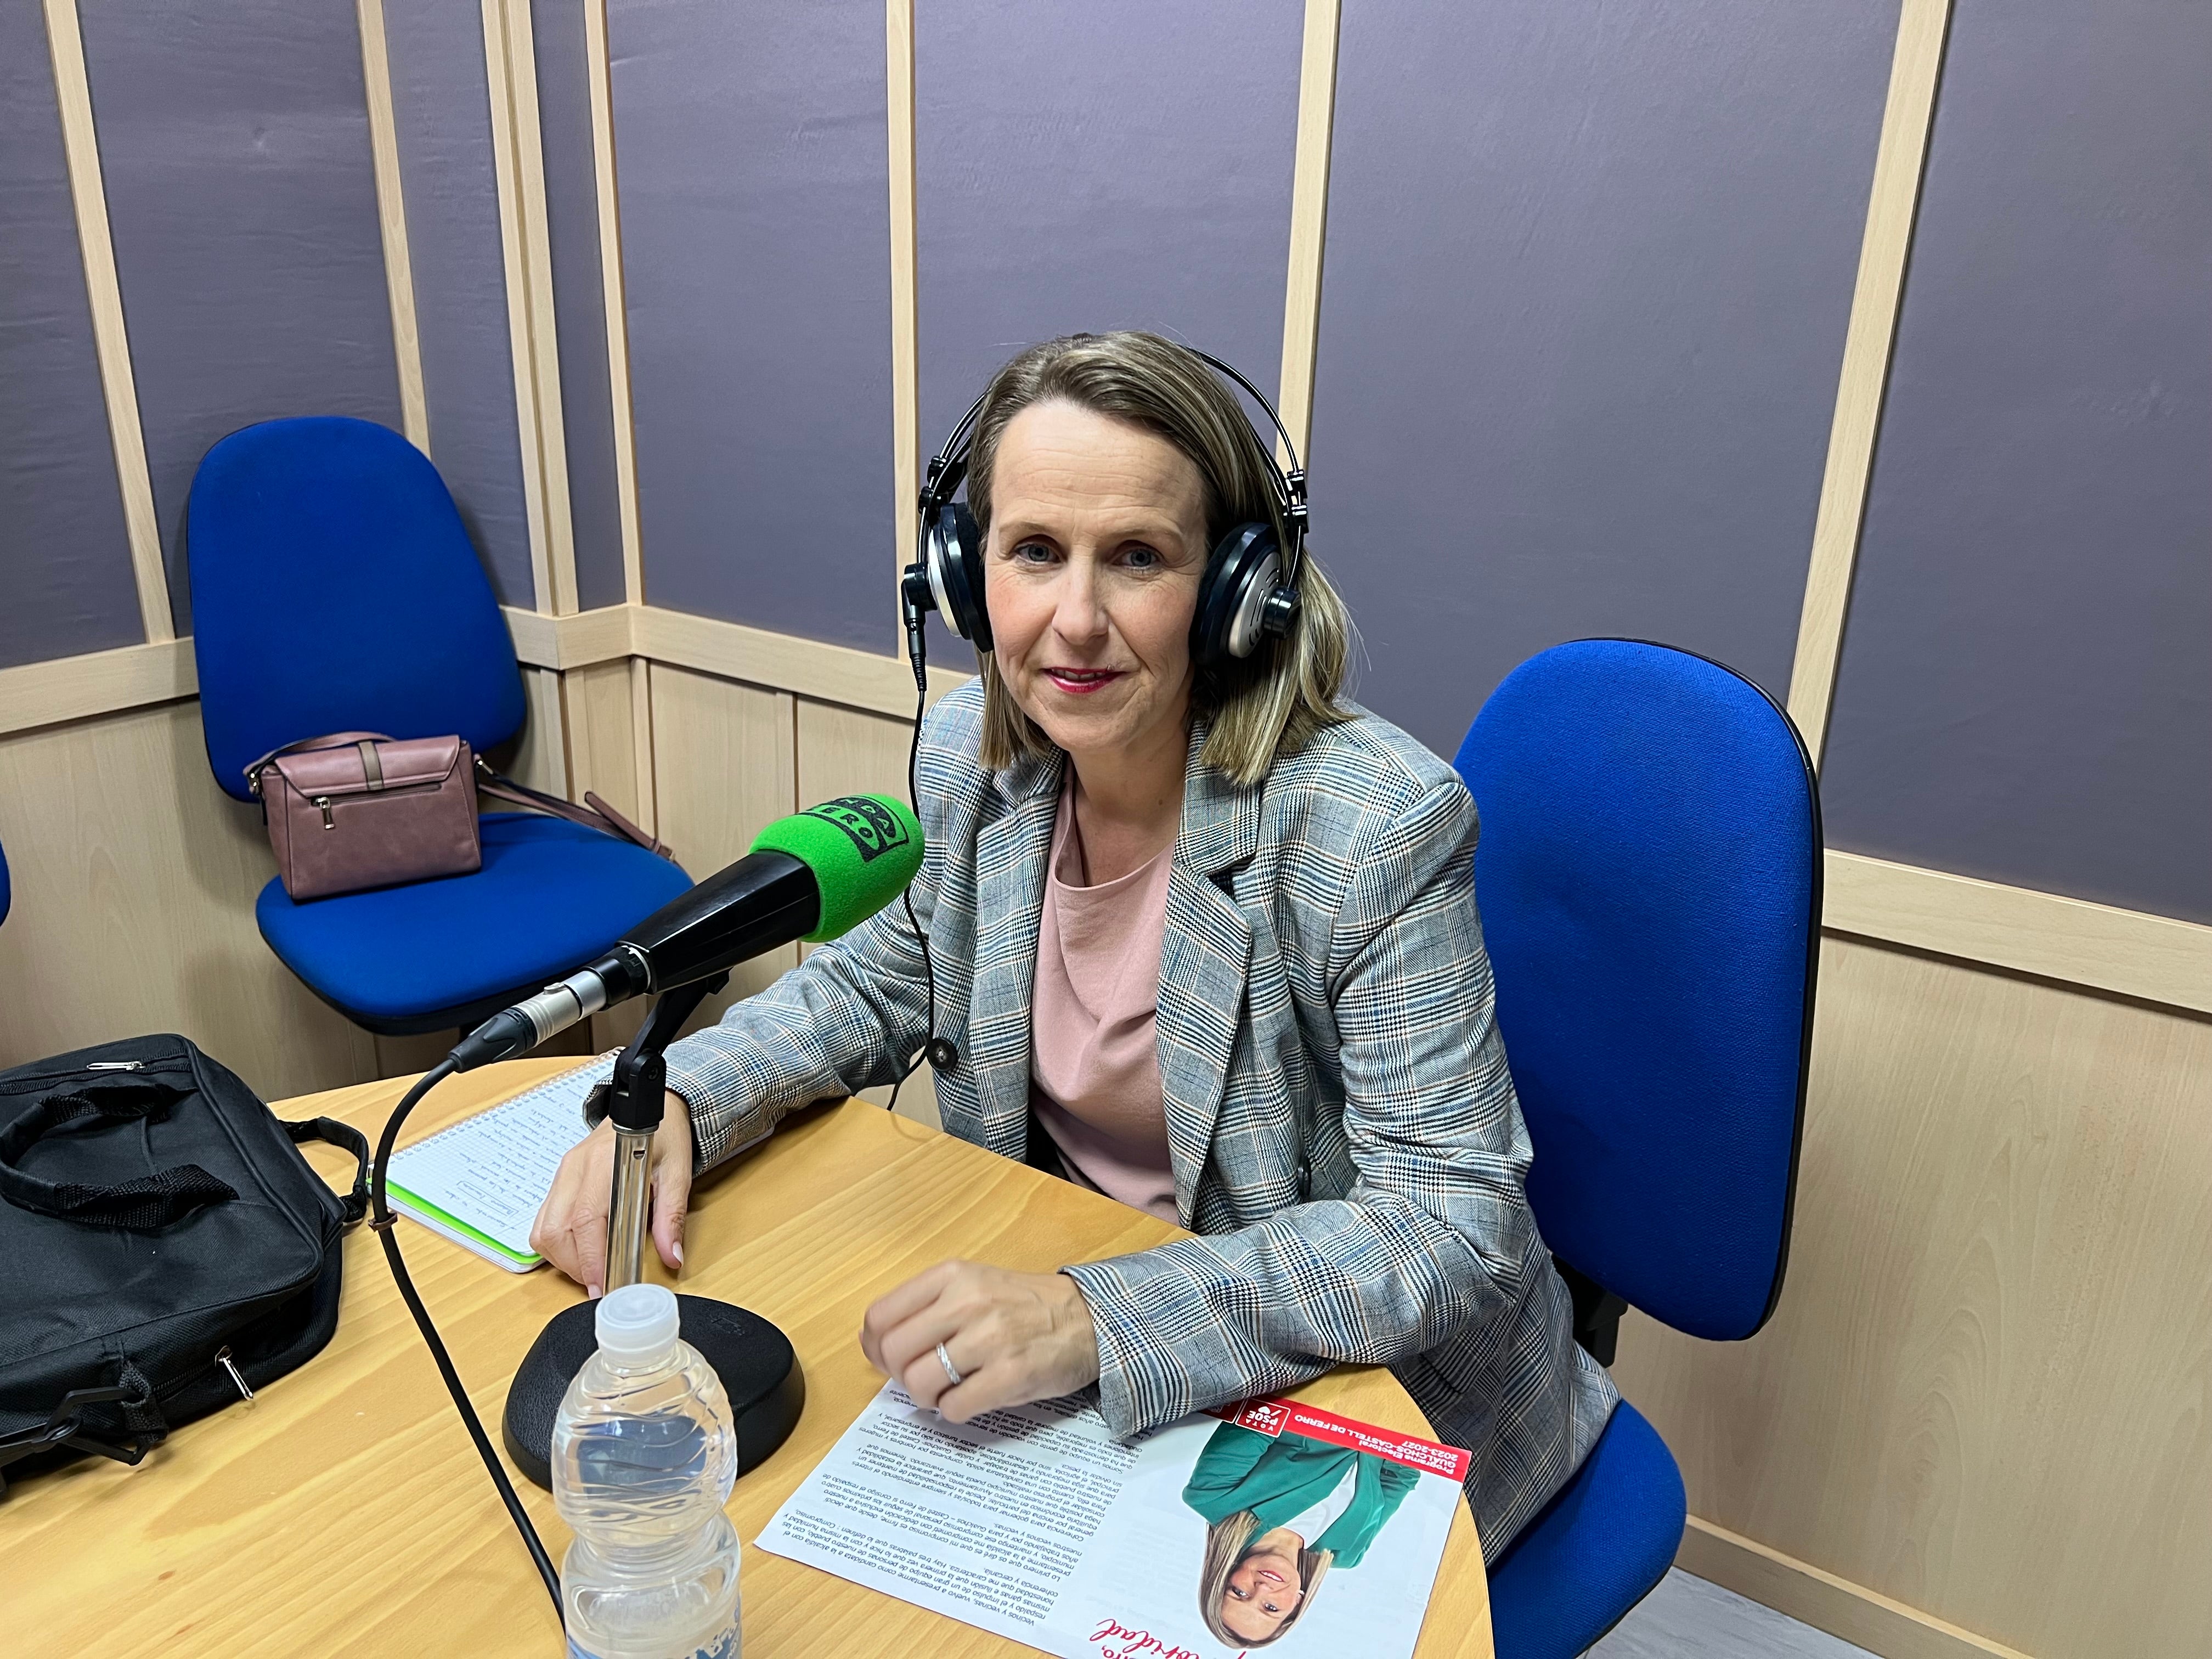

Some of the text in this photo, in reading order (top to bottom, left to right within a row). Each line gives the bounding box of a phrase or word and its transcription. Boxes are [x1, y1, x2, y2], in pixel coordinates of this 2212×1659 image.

[1245, 1418, 1274, 1431] VOTA
[1246, 1410, 1279, 1426] PSOE
[880, 1421, 900, 1430] sector
[858, 1427, 884, 1438] mujeres
[889, 1437, 917, 1450] hombres
[1294, 1414, 1457, 1468] GUALCHOS-CASTELL DE FERRO
[944, 1441, 977, 1455] apostando
[1402, 1440, 1459, 1462] 2023-2027
[861, 1449, 895, 1463] estabilidad
[929, 1450, 963, 1464] compuesta
[1358, 1440, 1454, 1475] Programa Electoral
[867, 1459, 899, 1472] mantener
[903, 1463, 933, 1475] garantice
[881, 1471, 921, 1486] entendiendo
[907, 1472, 957, 1491] responsabilidad
[986, 1469, 1024, 1483] candidatura
[1035, 1470, 1071, 1484] mejorando
[821, 1481, 842, 1491] cuatro
[921, 1483, 947, 1495] siempre
[1071, 1481, 1086, 1489] siga
[1086, 1486, 1100, 1494] que
[823, 1489, 849, 1500] nuestro
[842, 1488, 873, 1501] próximos
[965, 1491, 986, 1502] Desde
[994, 1493, 1019, 1504] nuestro
[1100, 1491, 1116, 1499] para
[854, 1500, 884, 1513] exclusiva
[883, 1502, 904, 1511] seguir
[983, 1504, 999, 1512] para
[1091, 1502, 1107, 1512] Para
[857, 1509, 878, 1519] desde
[884, 1510, 919, 1526] dedicación
[913, 1512, 944, 1525] personal
[998, 1509, 1030, 1522] gobernar
[781, 1521, 792, 1530] las
[943, 1522, 984, 1538] compromiso
[1030, 1519, 1047, 1528] para
[1066, 1516, 1097, 1531] equilibrio
[791, 1533, 804, 1541] con
[909, 1526, 949, 1543] compromiso
[1046, 1525, 1084, 1542] Coherencia
[1067, 1525, 1094, 1537] general
[804, 1538, 830, 1550] alcaldía
[831, 1540, 857, 1552] nuestro
[1025, 1533, 1051, 1546] vecinos
[959, 1543, 974, 1551] que
[986, 1544, 1012, 1556] alcaldía
[997, 1540, 1033, 1555] mantengo
[1052, 1543, 1083, 1556] nuestros
[844, 1553, 877, 1568] candidata
[867, 1553, 899, 1567] personas
[983, 1551, 998, 1560] diré
[1008, 1559, 1023, 1567] que
[1027, 1558, 1071, 1577] presentarme
[877, 1565, 897, 1575] como
[909, 1568, 933, 1580] equipo
[1023, 1565, 1052, 1577] primero
[897, 1572, 942, 1591] presentarme
[933, 1576, 951, 1586] gran
[947, 1590, 970, 1602] vuelvo
[1020, 1581, 1059, 1598] coherencia
[972, 1590, 1000, 1605] impulso
[1015, 1605, 1046, 1620] respaldo
[1007, 1612, 1035, 1627] Vecinos
[1090, 1618, 1246, 1659] oridad
